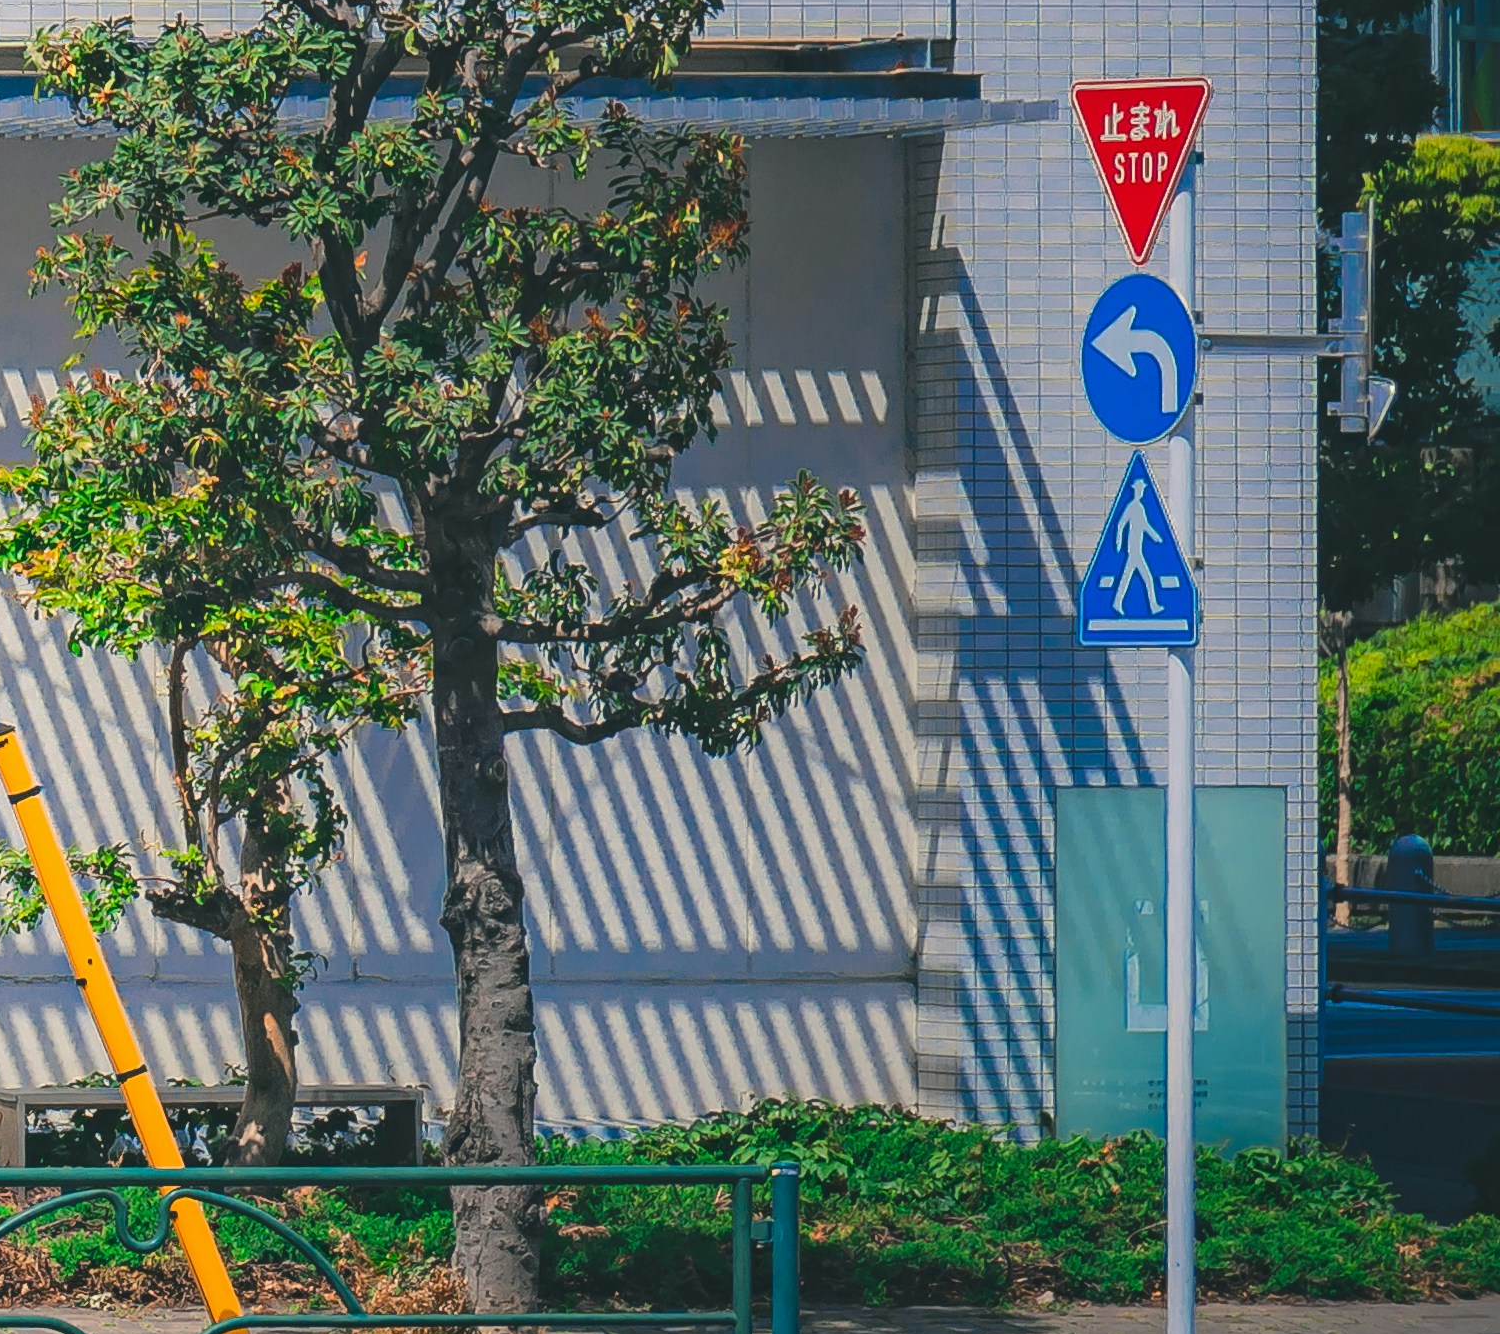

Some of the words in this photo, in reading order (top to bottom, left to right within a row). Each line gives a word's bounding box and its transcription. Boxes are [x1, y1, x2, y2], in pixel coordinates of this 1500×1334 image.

[1100, 100, 1181, 142] 止まれ
[1114, 151, 1169, 184] STOP
